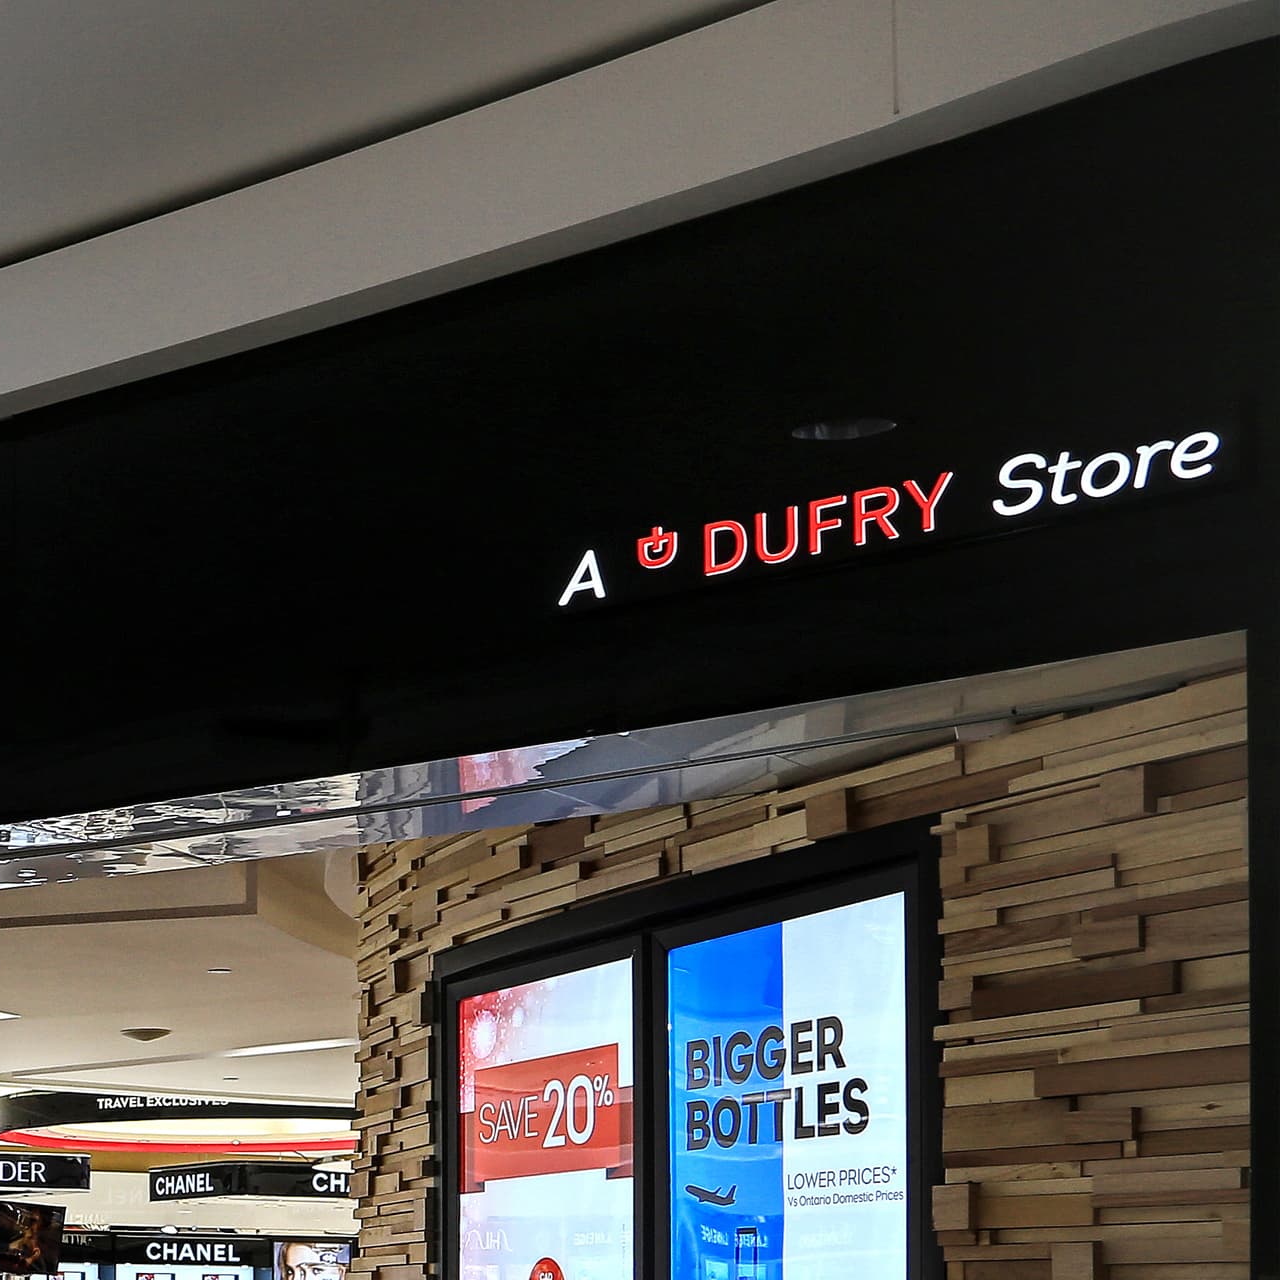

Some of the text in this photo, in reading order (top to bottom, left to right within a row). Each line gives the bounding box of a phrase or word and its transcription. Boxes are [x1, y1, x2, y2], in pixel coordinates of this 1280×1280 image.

[558, 430, 1221, 607] A DUFRY Store
[685, 1015, 847, 1091] BIGGER
[96, 1096, 144, 1110] TRAVEL
[479, 1073, 614, 1149] SAVE 20%
[685, 1077, 870, 1152] BOTTLES
[154, 1172, 215, 1196] CHANEL
[787, 1170, 837, 1191] LOWER
[787, 1189, 904, 1207] Vs Ontario Domestic Prices
[145, 1241, 241, 1263] CHANEL
